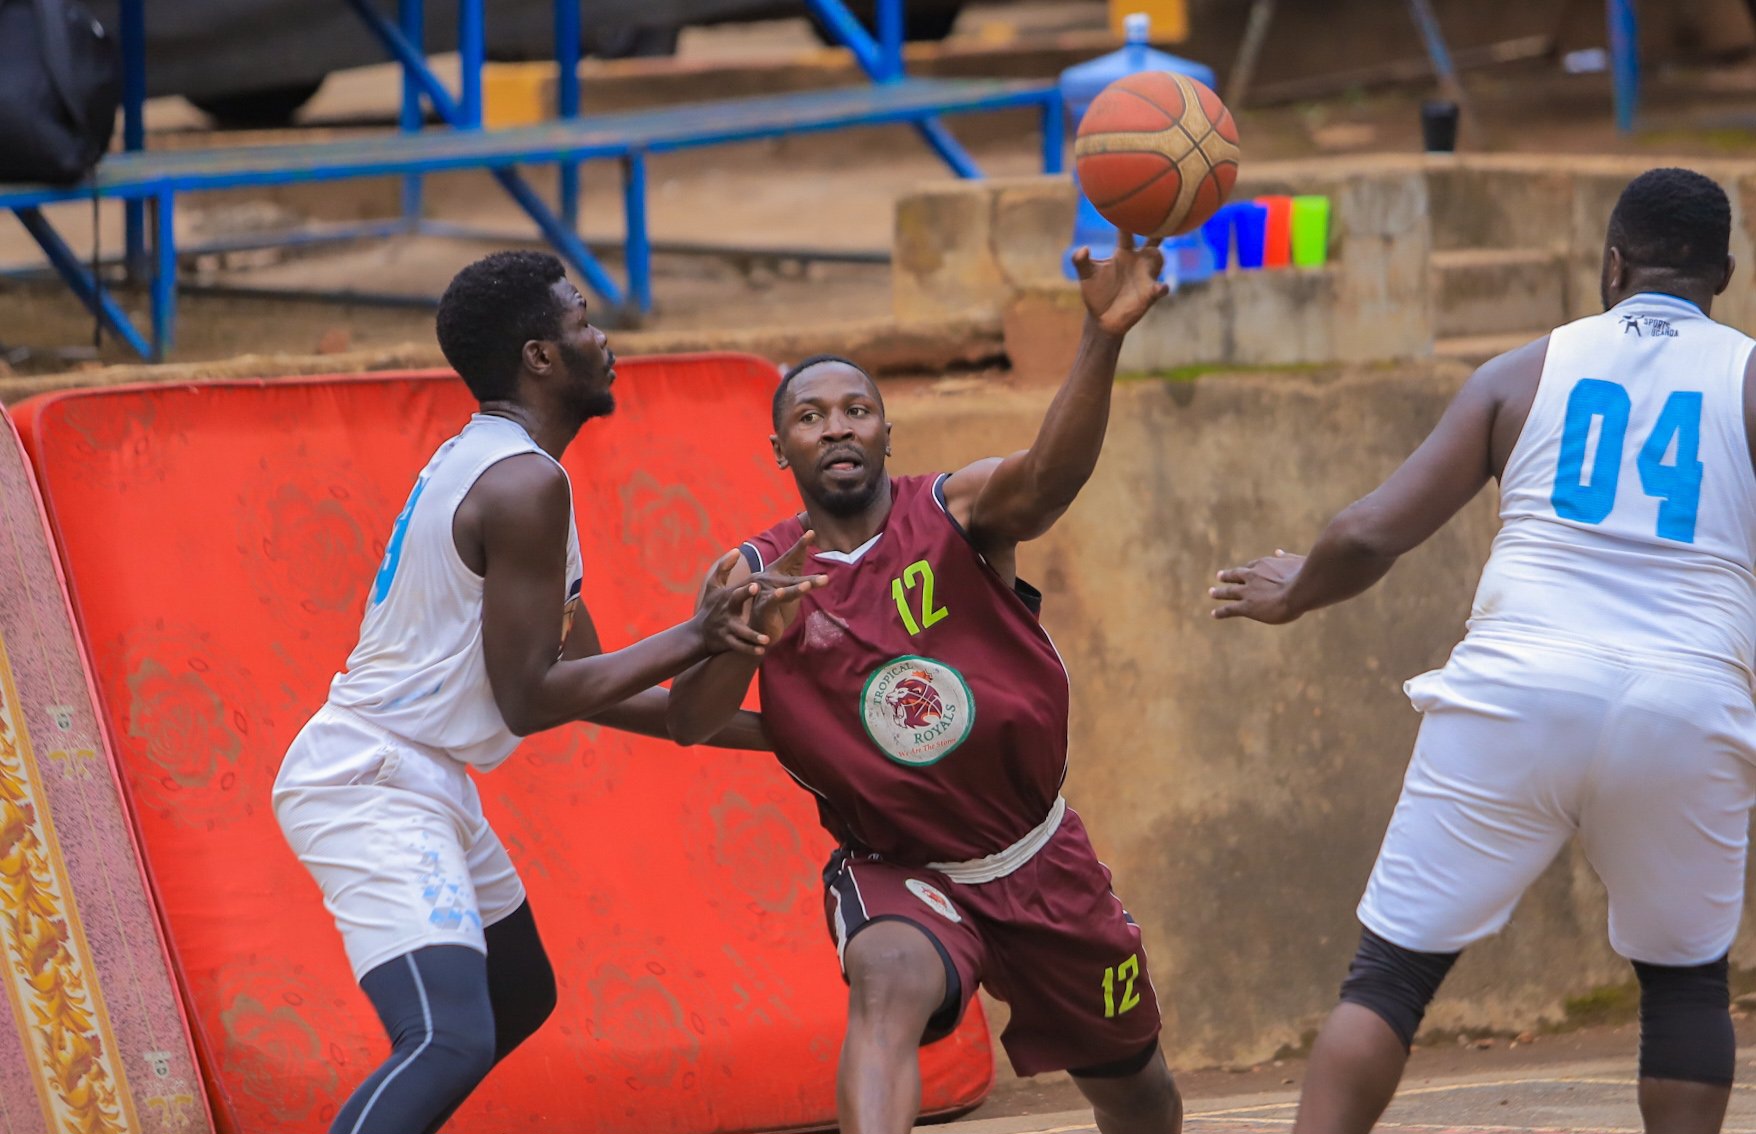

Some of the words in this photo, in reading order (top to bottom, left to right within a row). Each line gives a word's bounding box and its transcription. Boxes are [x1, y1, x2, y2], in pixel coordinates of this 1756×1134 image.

[1643, 318, 1670, 330] SPORTS
[1651, 329, 1679, 337] UGANDA
[1550, 378, 1703, 544] 04
[892, 560, 949, 636] 12
[874, 662, 913, 705] TROPICAL
[914, 704, 956, 744] ROYALS
[922, 744, 935, 752] The
[1101, 953, 1140, 1018] 12
